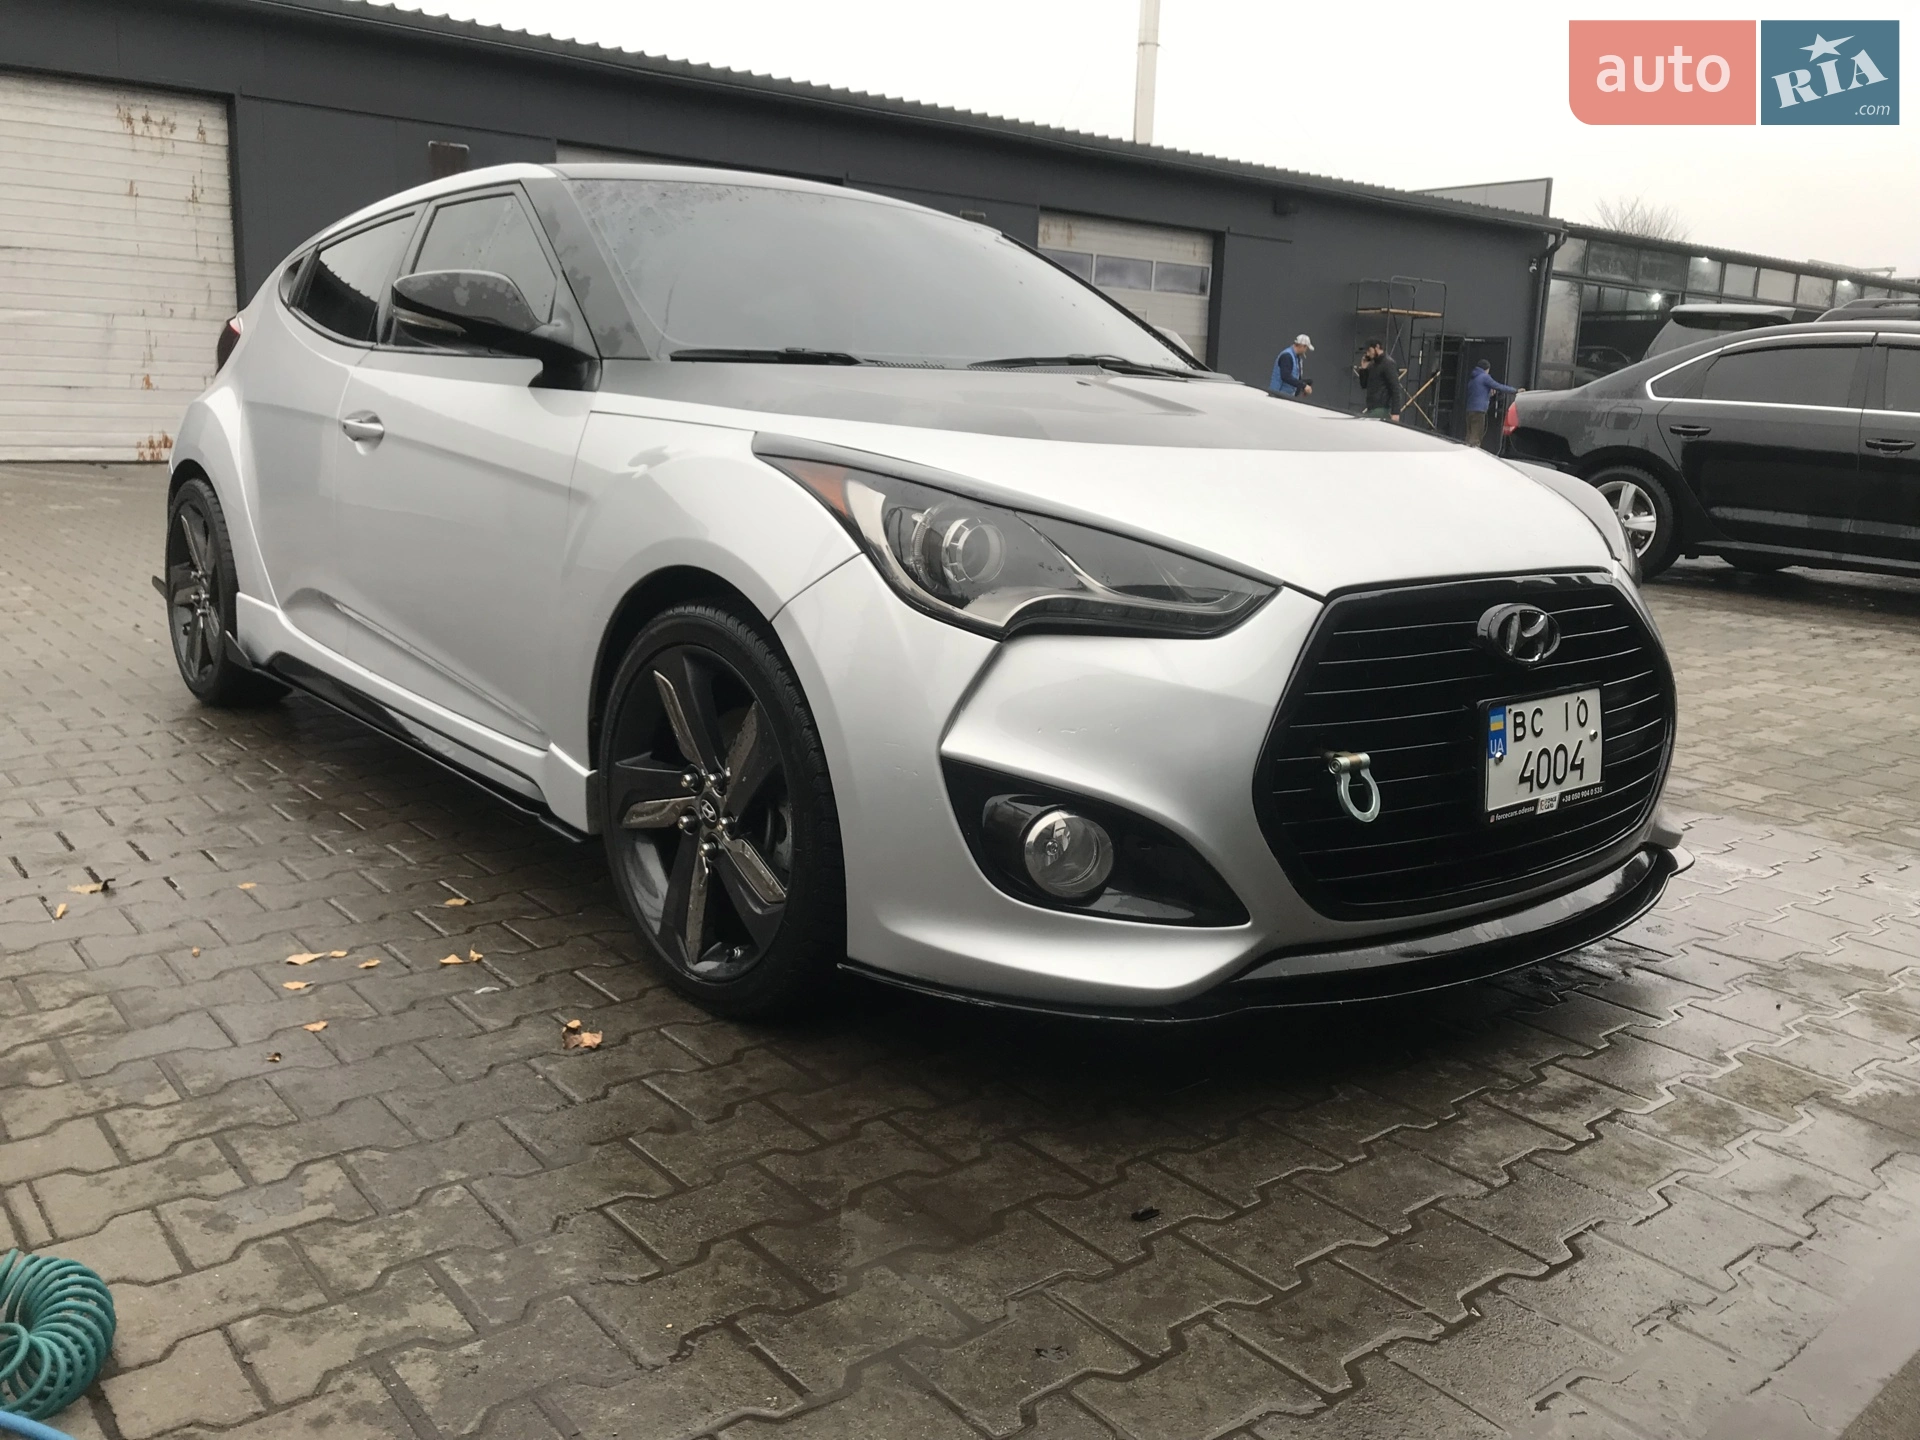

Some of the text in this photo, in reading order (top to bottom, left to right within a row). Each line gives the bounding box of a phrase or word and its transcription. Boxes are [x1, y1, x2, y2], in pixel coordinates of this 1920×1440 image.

[1513, 707, 1544, 743] BC
[1490, 737, 1505, 755] UA
[1518, 739, 1585, 793] 4004
